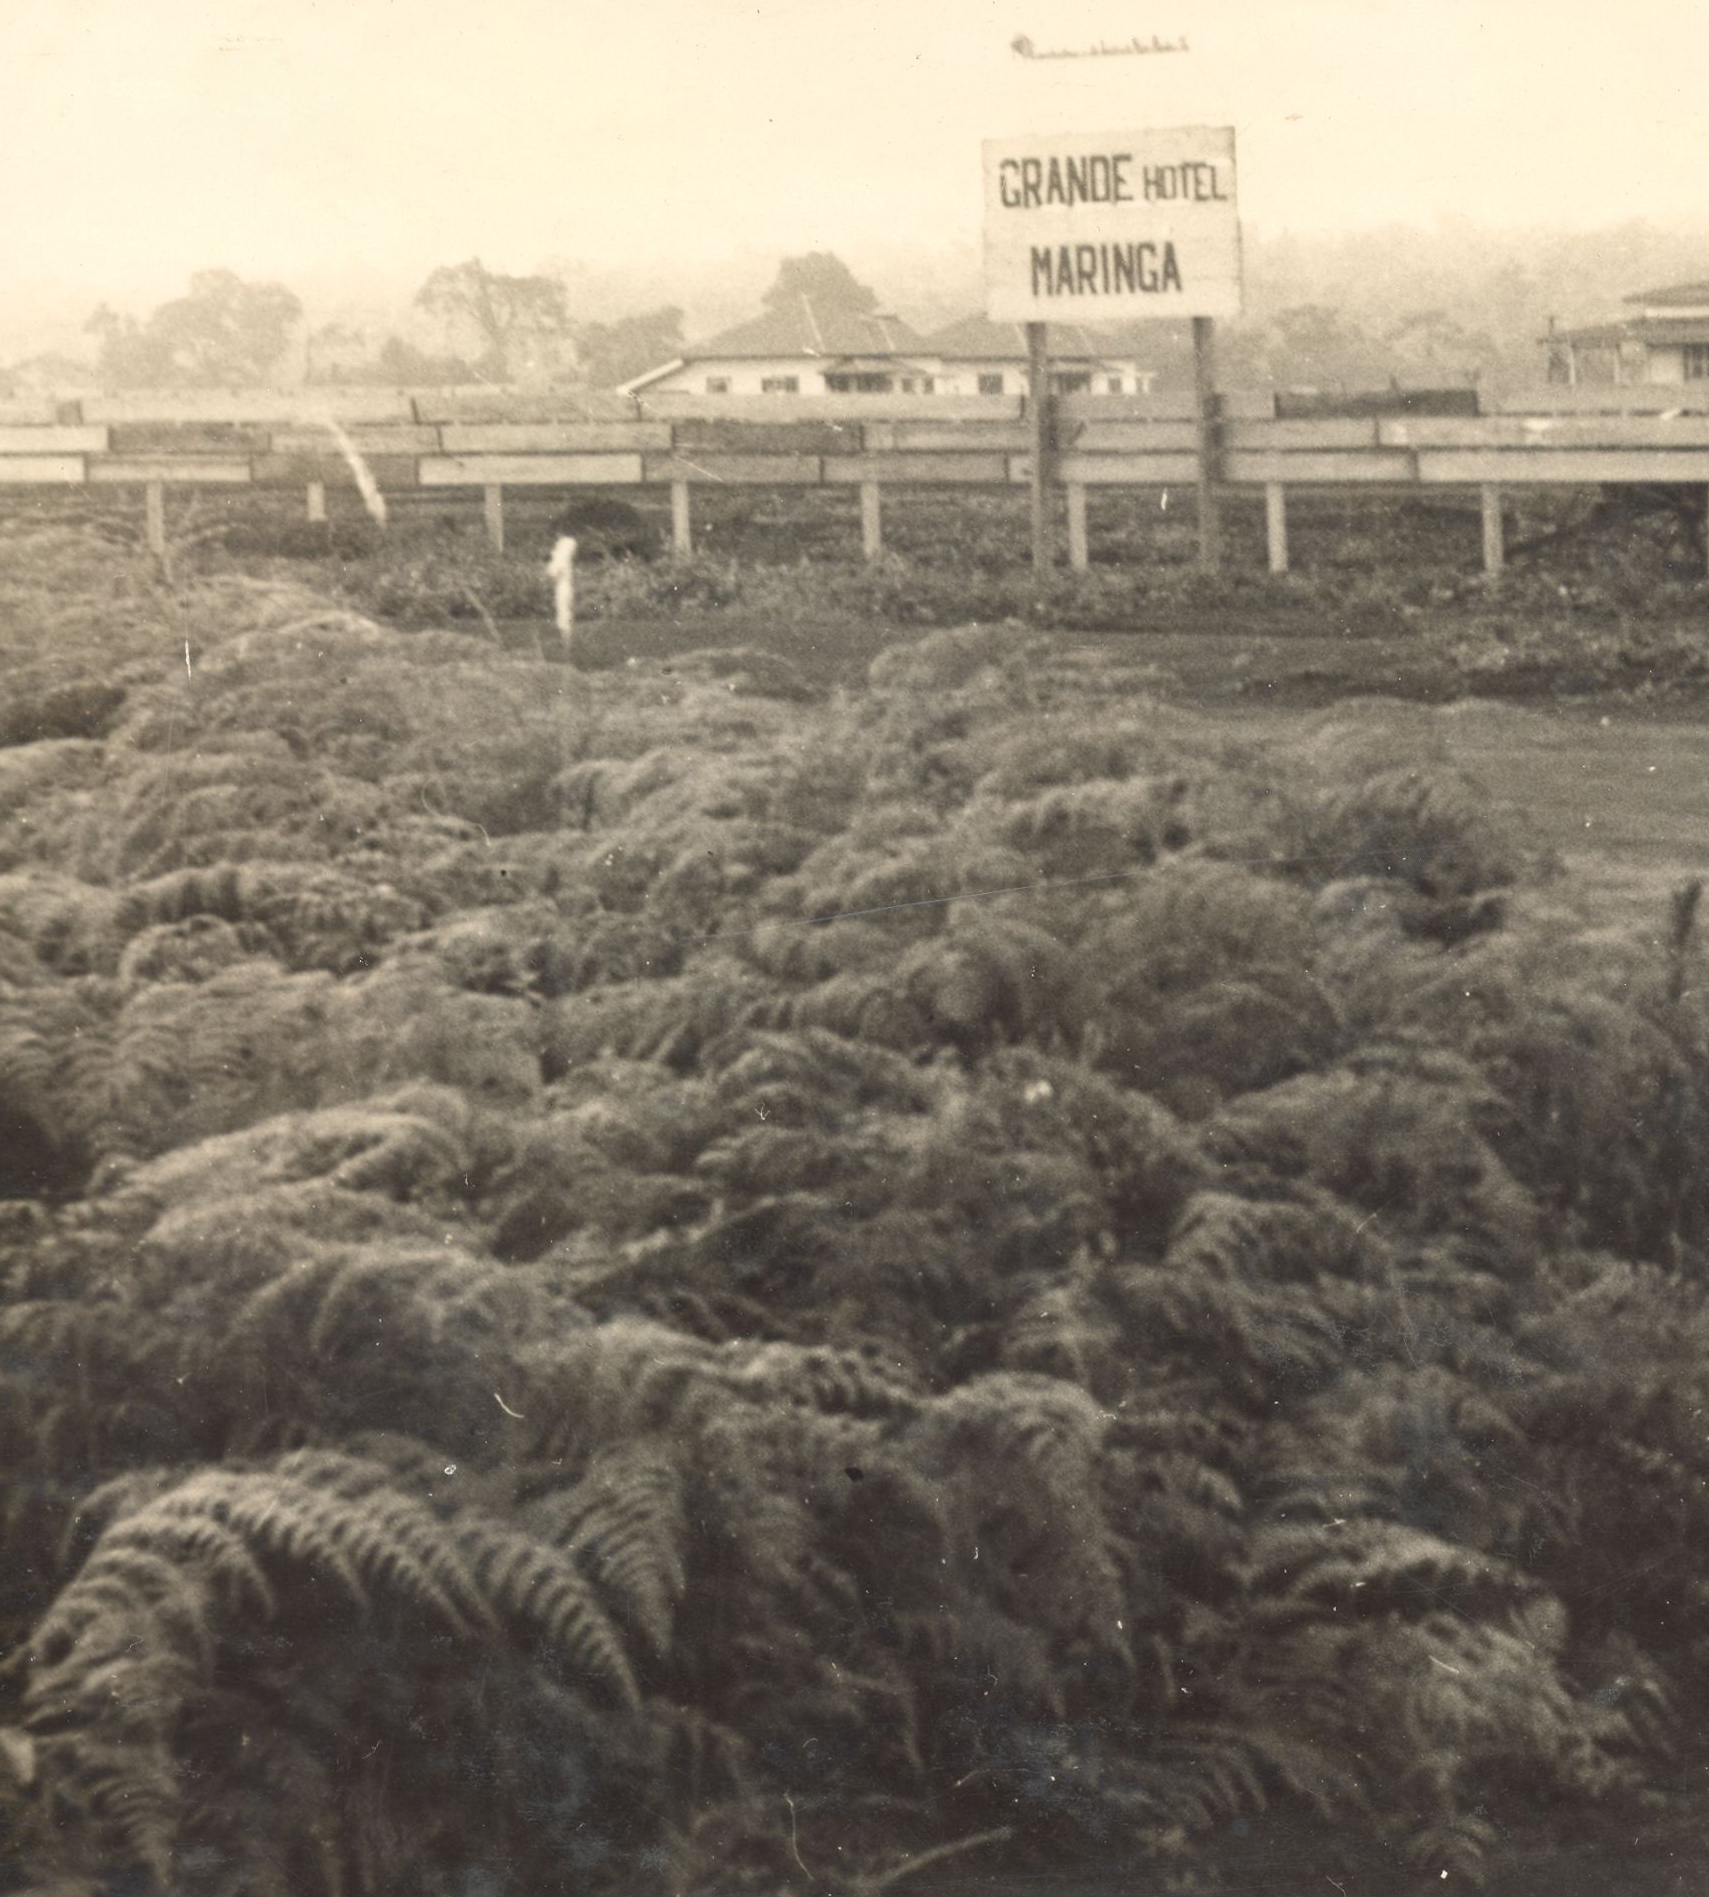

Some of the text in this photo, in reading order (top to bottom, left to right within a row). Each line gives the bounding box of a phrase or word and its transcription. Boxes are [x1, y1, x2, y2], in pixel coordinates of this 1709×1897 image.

[1000, 154, 1228, 208] GRANDE HOTEL
[1030, 241, 1183, 297] MARINGA
